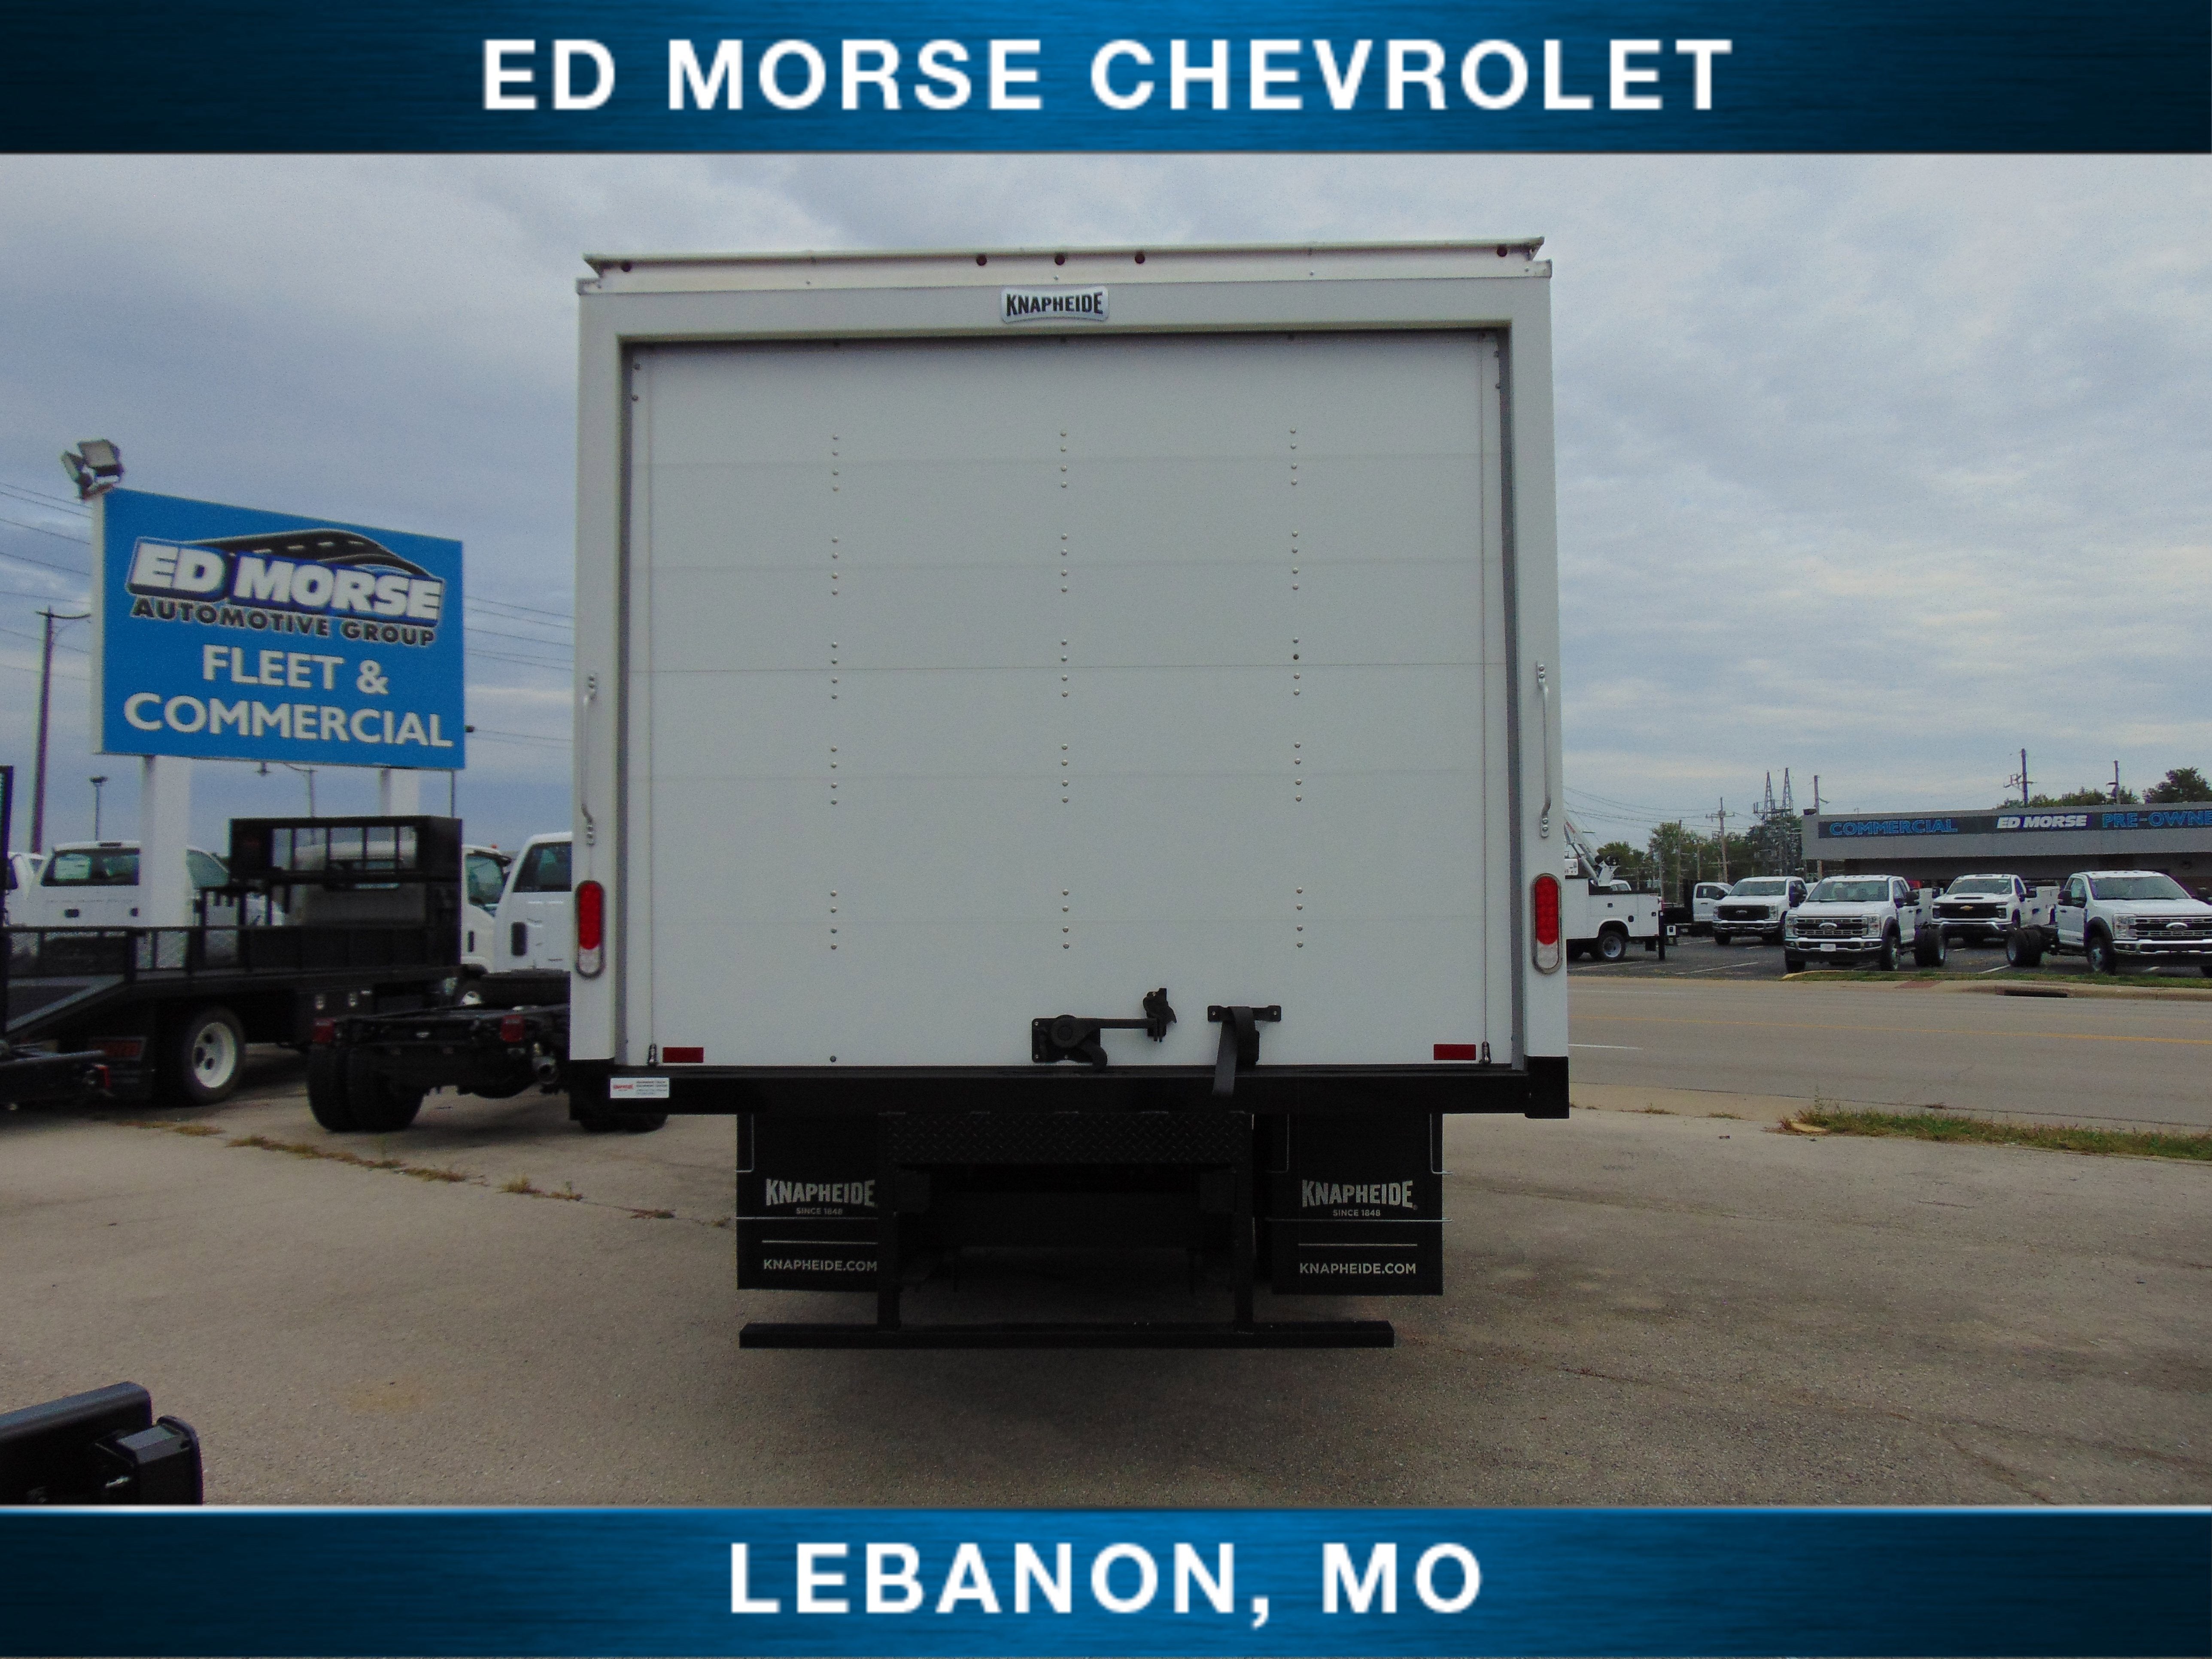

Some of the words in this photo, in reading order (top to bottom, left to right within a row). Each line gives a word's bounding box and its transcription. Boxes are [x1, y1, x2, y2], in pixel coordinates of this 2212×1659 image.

[1006, 291, 1103, 316] KNAPHEIDE
[131, 542, 222, 594] ED
[234, 556, 441, 621] MORSE
[131, 598, 330, 636] AUTOMOTIVE
[341, 621, 434, 646] GROUP
[204, 645, 344, 690] FLEET
[357, 659, 389, 694] &
[124, 693, 453, 747] COMMERCIAL
[1829, 819, 1958, 836] COMMERCIAL
[1996, 816, 2021, 829] ED
[2024, 814, 2087, 828] MORSE
[766, 1179, 875, 1207] KNAPHEIDE
[1302, 1179, 1413, 1208] KNAPHEIDE
[763, 1259, 877, 1271] KNAPHEIDE.COM
[1299, 1263, 1416, 1274] KNAPHEIDE.COM
